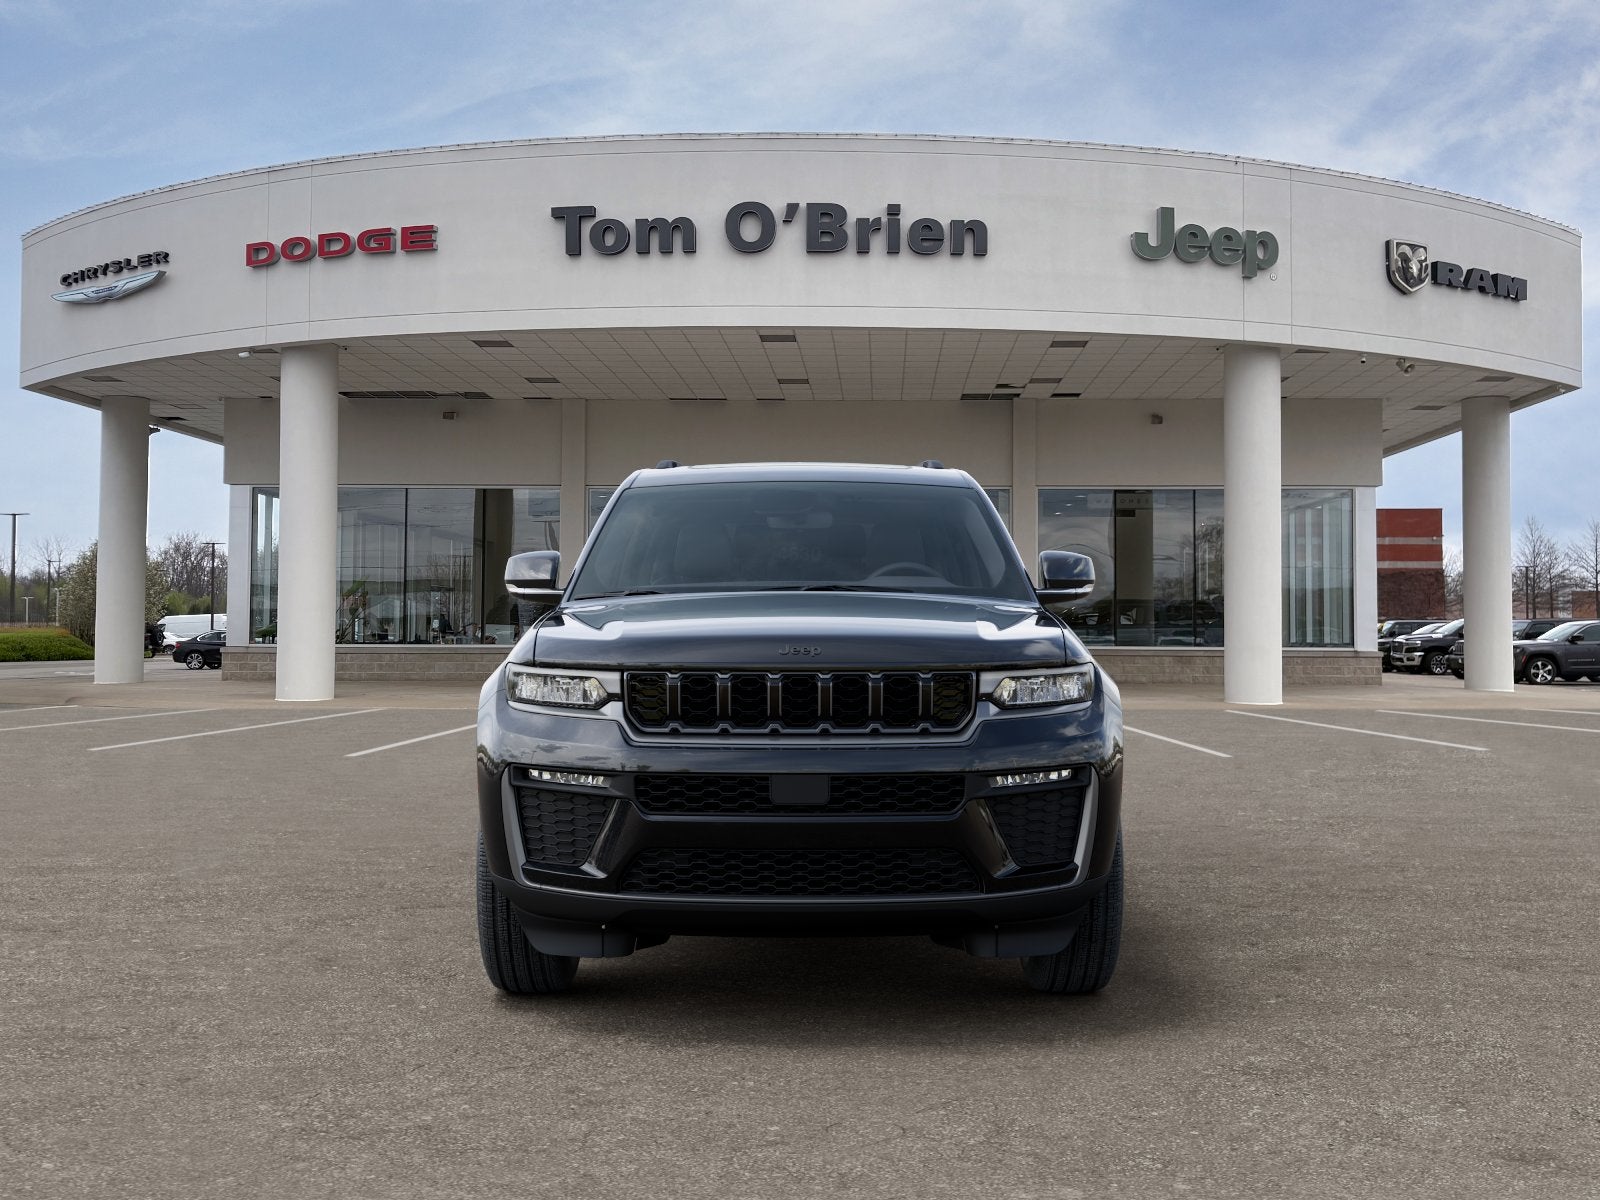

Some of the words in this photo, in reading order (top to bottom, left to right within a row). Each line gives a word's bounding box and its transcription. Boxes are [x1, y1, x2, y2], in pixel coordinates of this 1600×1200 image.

[246, 224, 439, 268] DODGE
[551, 205, 697, 256] Tom
[725, 201, 988, 257] O'Brien
[1131, 207, 1279, 278] Jeep
[59, 250, 170, 287] CHRYSLER
[1431, 261, 1528, 302] RAM
[779, 643, 822, 657] Jeep
